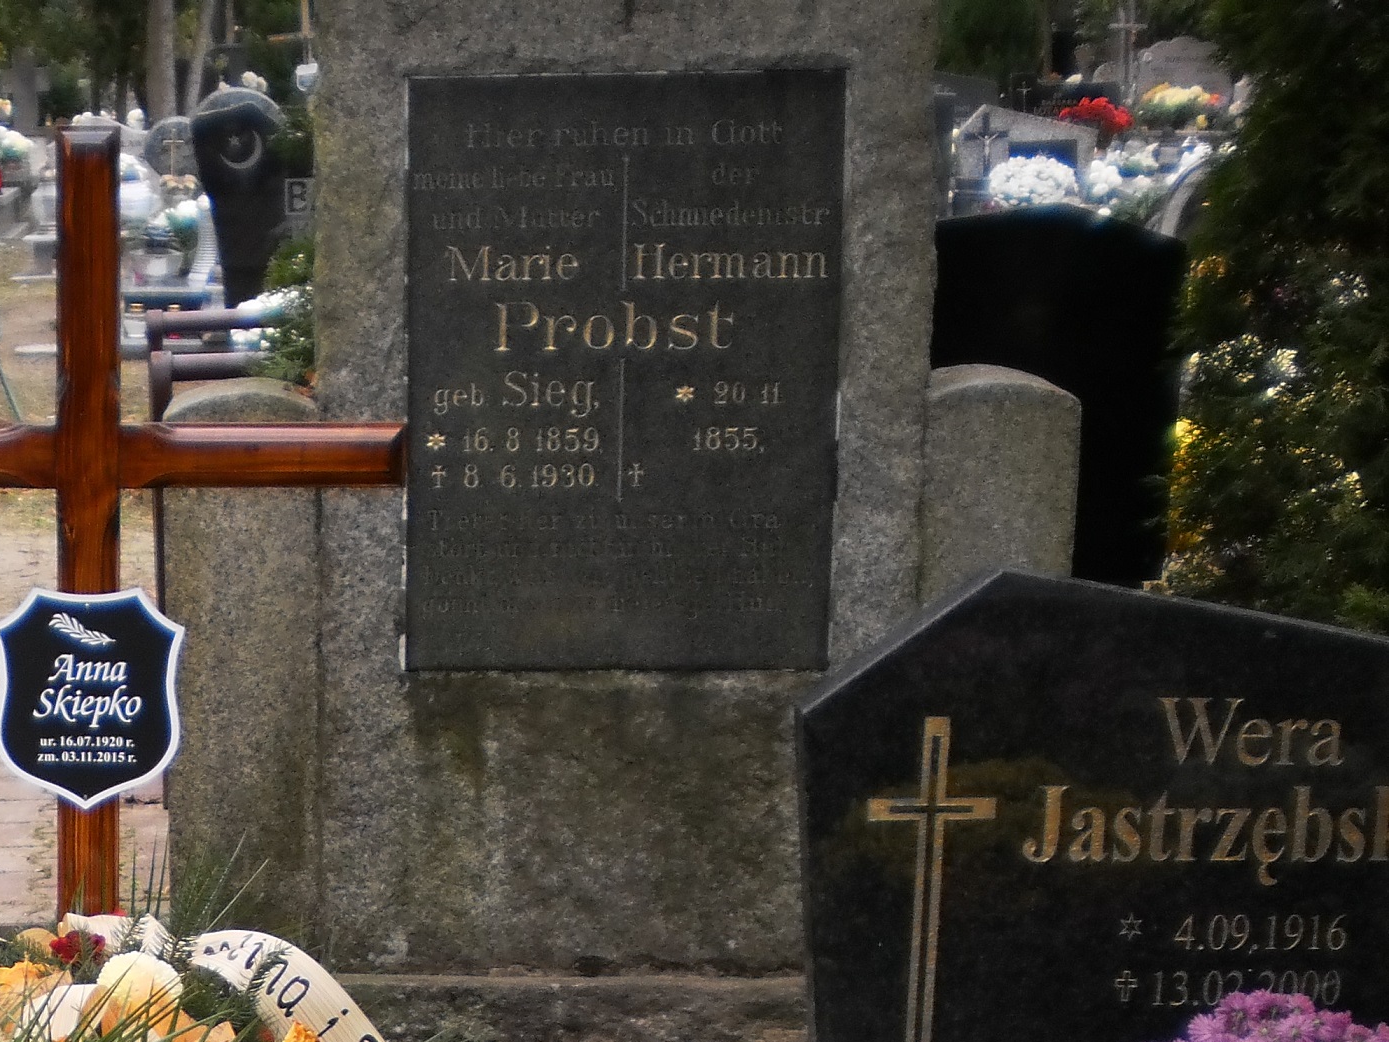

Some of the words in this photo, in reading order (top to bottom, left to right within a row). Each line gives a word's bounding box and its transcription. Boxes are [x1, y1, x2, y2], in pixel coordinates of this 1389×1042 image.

[447, 245, 579, 282] Marie
[633, 243, 830, 281] Hermann
[493, 300, 735, 352] Probst
[48, 653, 127, 681] Anna
[32, 684, 142, 728] Skiepko
[39, 737, 57, 747] ur.
[60, 735, 123, 747] 16.07.1920
[125, 737, 135, 747] r.
[1157, 697, 1344, 767] Wera
[37, 753, 59, 762] zm.
[61, 751, 125, 763] 03.11.2015
[127, 753, 137, 763] r.
